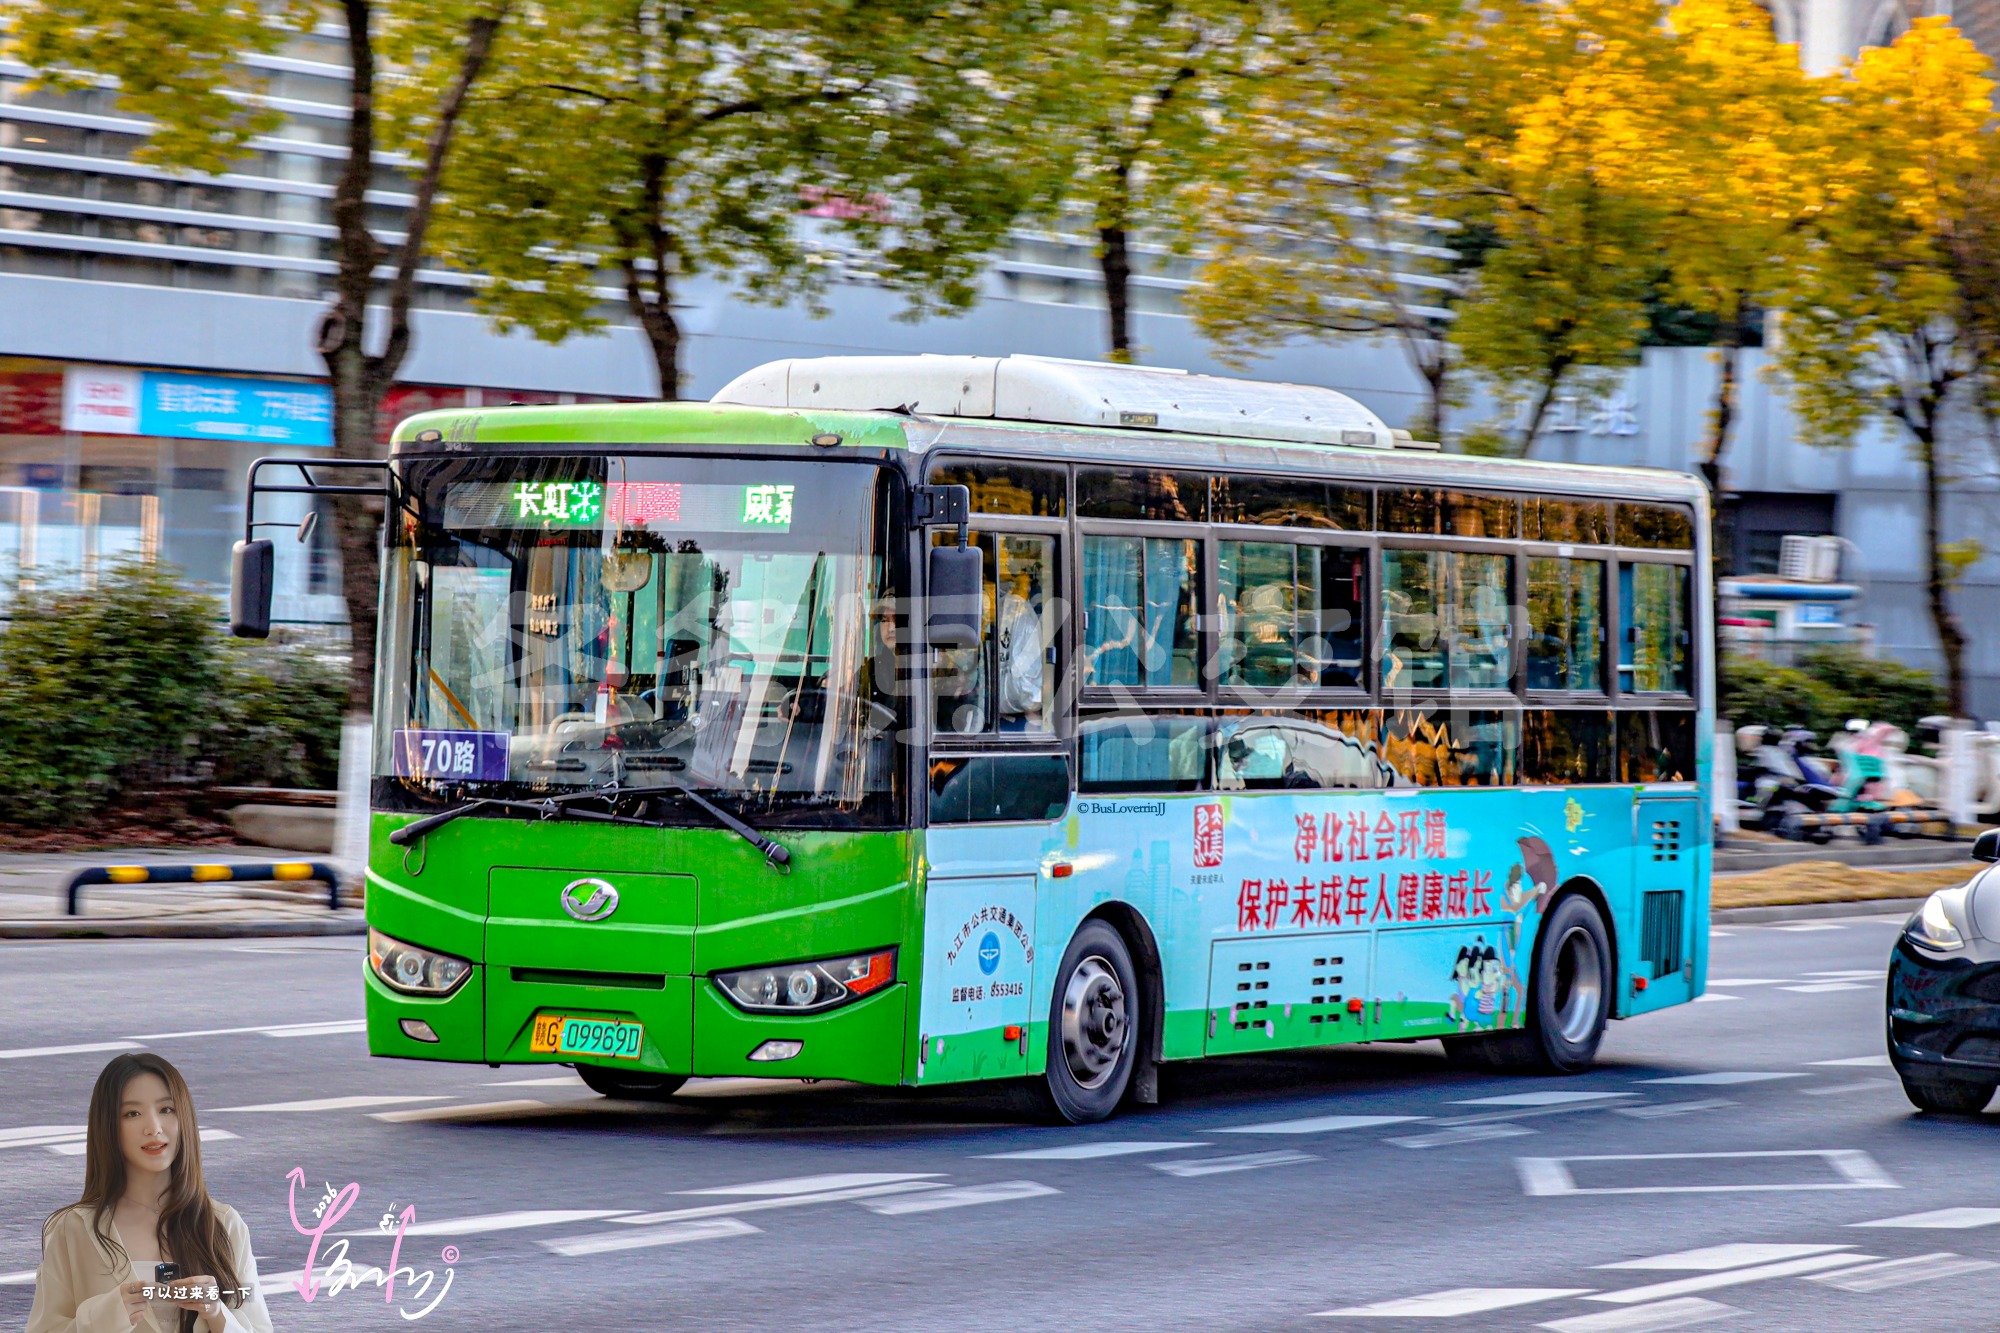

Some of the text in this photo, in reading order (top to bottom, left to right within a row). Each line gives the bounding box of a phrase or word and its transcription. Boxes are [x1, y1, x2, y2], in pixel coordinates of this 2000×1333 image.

[513, 482, 574, 518] 长虹
[421, 739, 475, 774] 70路
[1294, 808, 1448, 864] 净化社会环境
[1236, 869, 1494, 933] 保护未成年人健康成长
[946, 905, 1036, 966] 九江市公共交通集团公司
